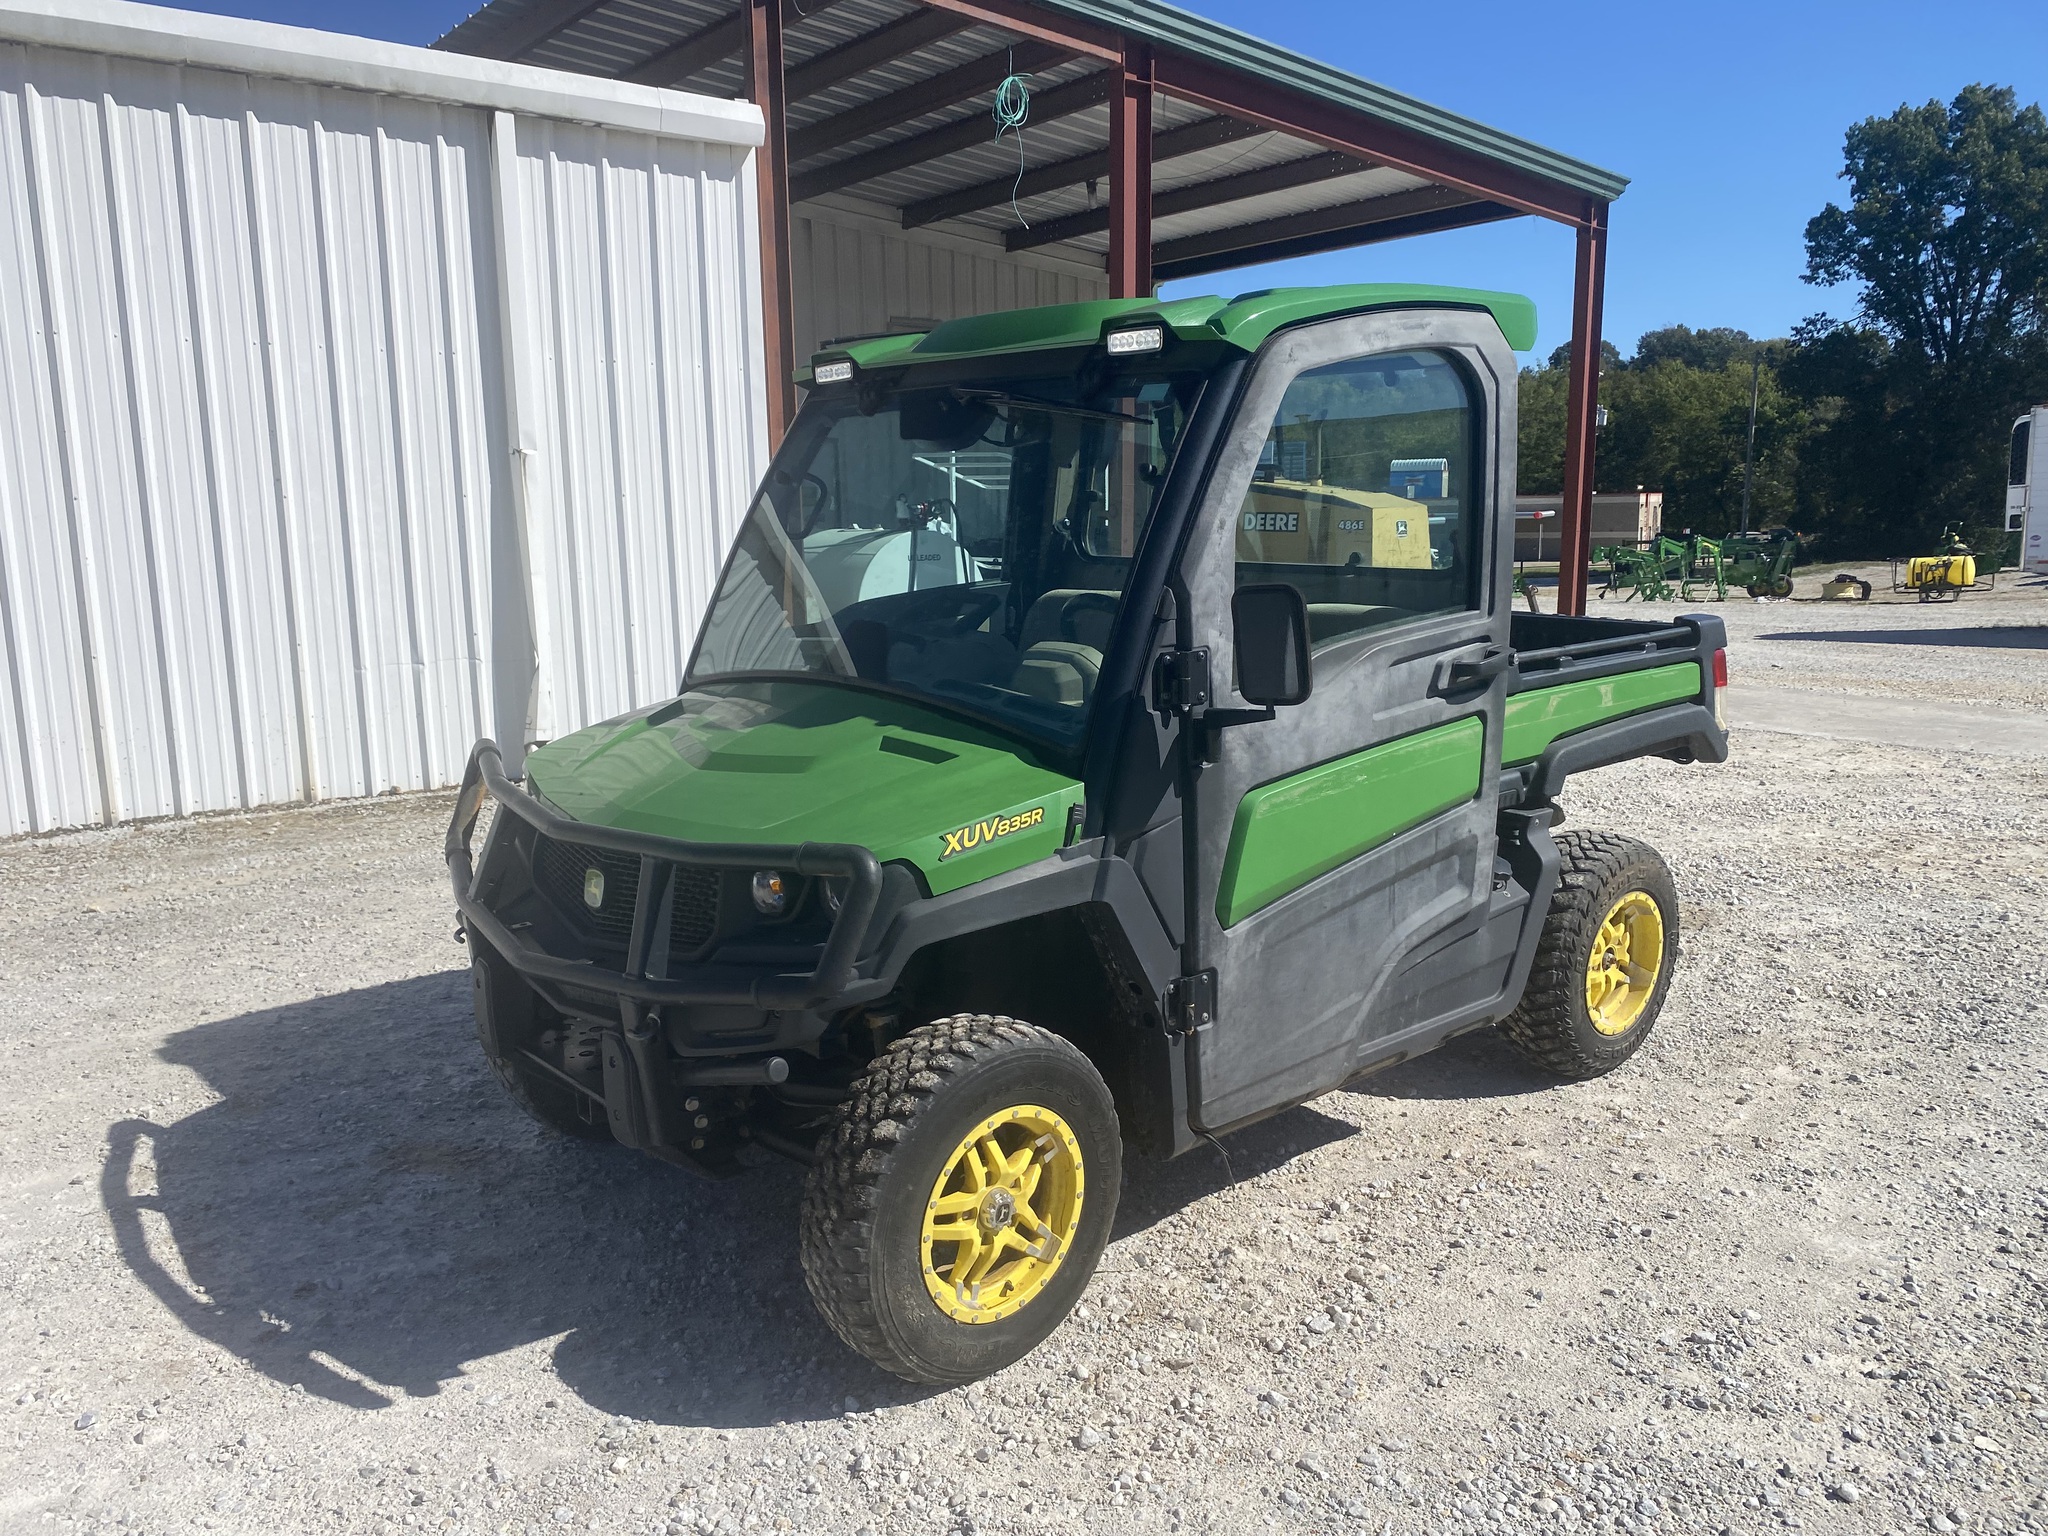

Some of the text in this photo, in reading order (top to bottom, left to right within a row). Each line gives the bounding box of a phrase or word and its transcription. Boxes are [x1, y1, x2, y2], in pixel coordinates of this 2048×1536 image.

[1243, 513, 1299, 531] DEERE
[1338, 520, 1364, 530] 486E
[908, 553, 942, 561] ULEADED
